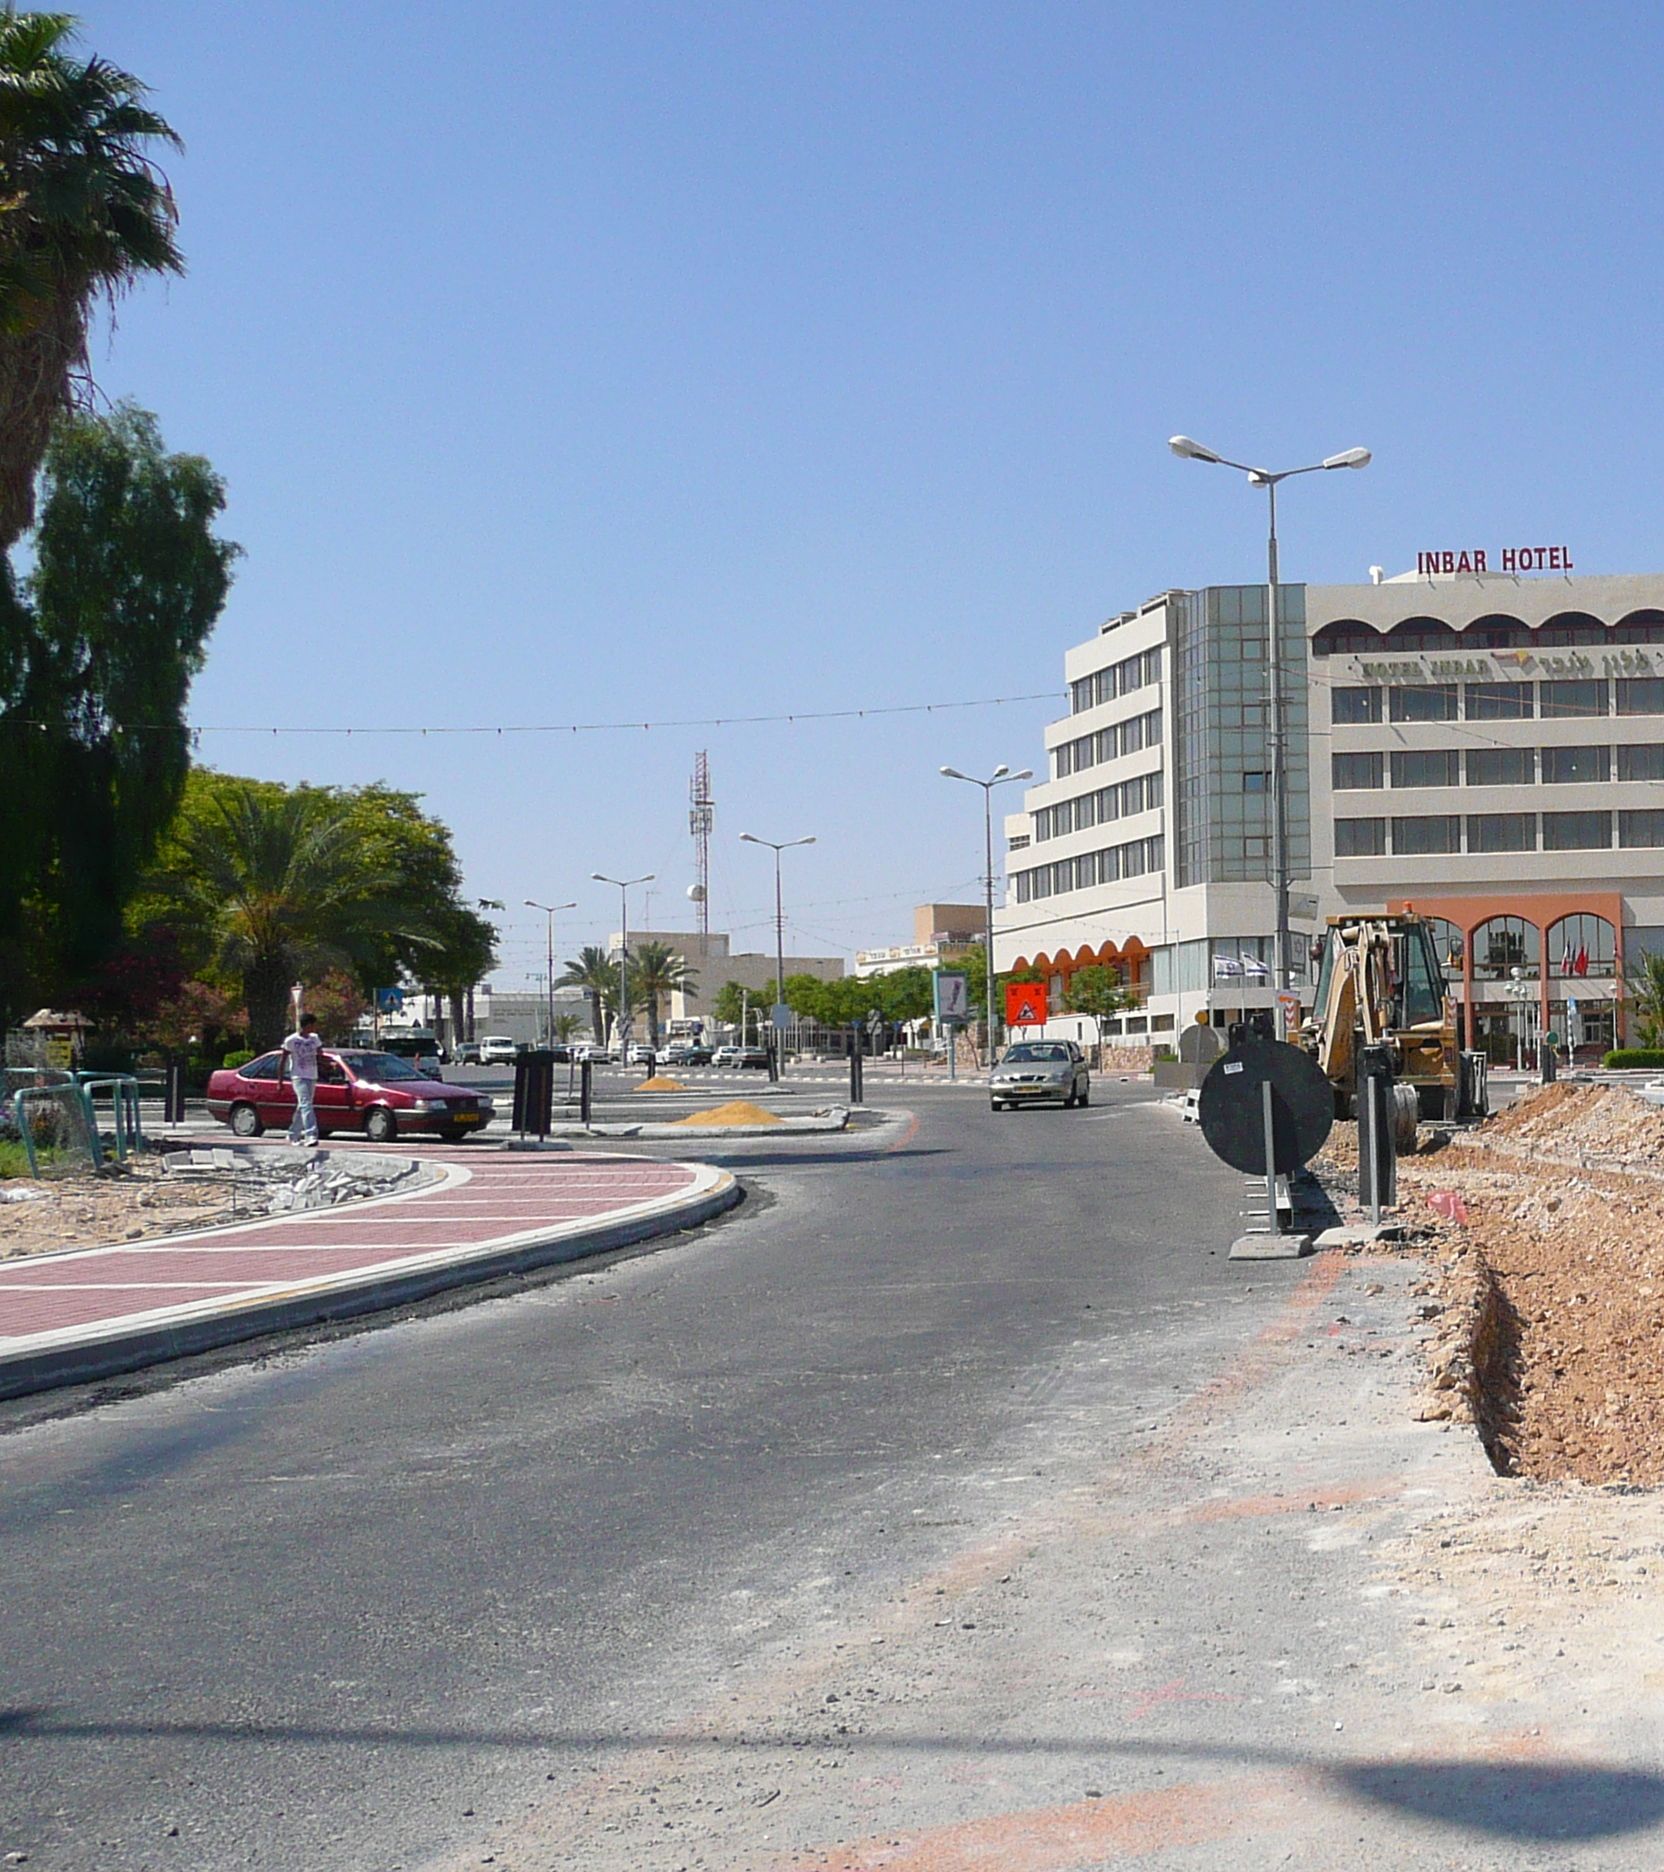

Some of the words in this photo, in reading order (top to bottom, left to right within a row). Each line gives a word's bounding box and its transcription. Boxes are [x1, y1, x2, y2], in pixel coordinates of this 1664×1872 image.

[1417, 550, 1487, 574] INBAR
[1502, 546, 1574, 571] HOTEL
[1430, 658, 1488, 676] INBAR
